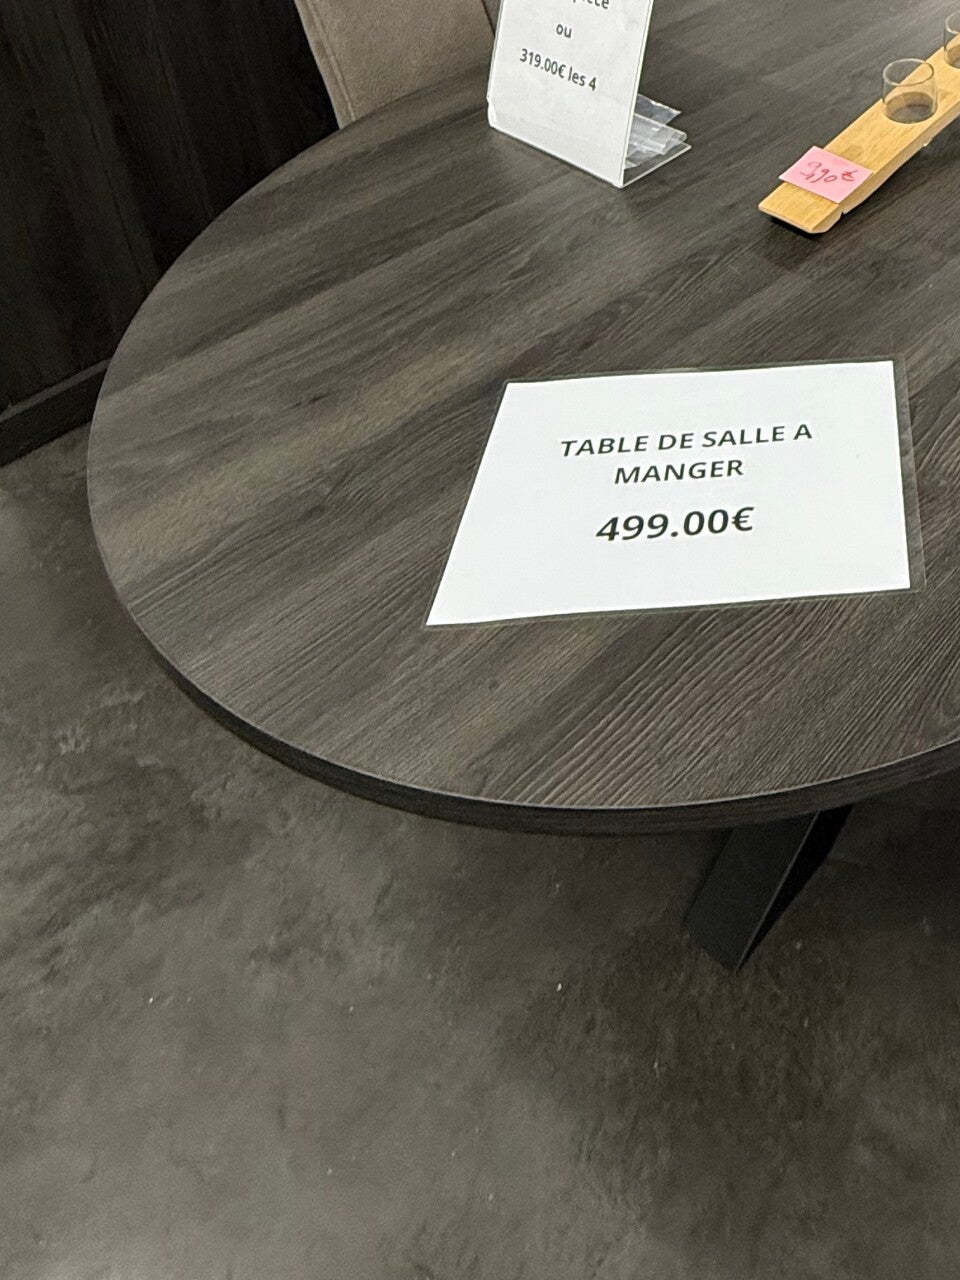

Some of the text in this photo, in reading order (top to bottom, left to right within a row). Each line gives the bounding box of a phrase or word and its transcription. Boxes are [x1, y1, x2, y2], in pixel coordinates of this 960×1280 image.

[555, 23, 572, 39] ou
[519, 47, 597, 92] 319.00€ les 4
[561, 423, 813, 457] TABLE DE SALLE A
[614, 459, 744, 484] MANGER
[595, 506, 755, 542] 499.00€
